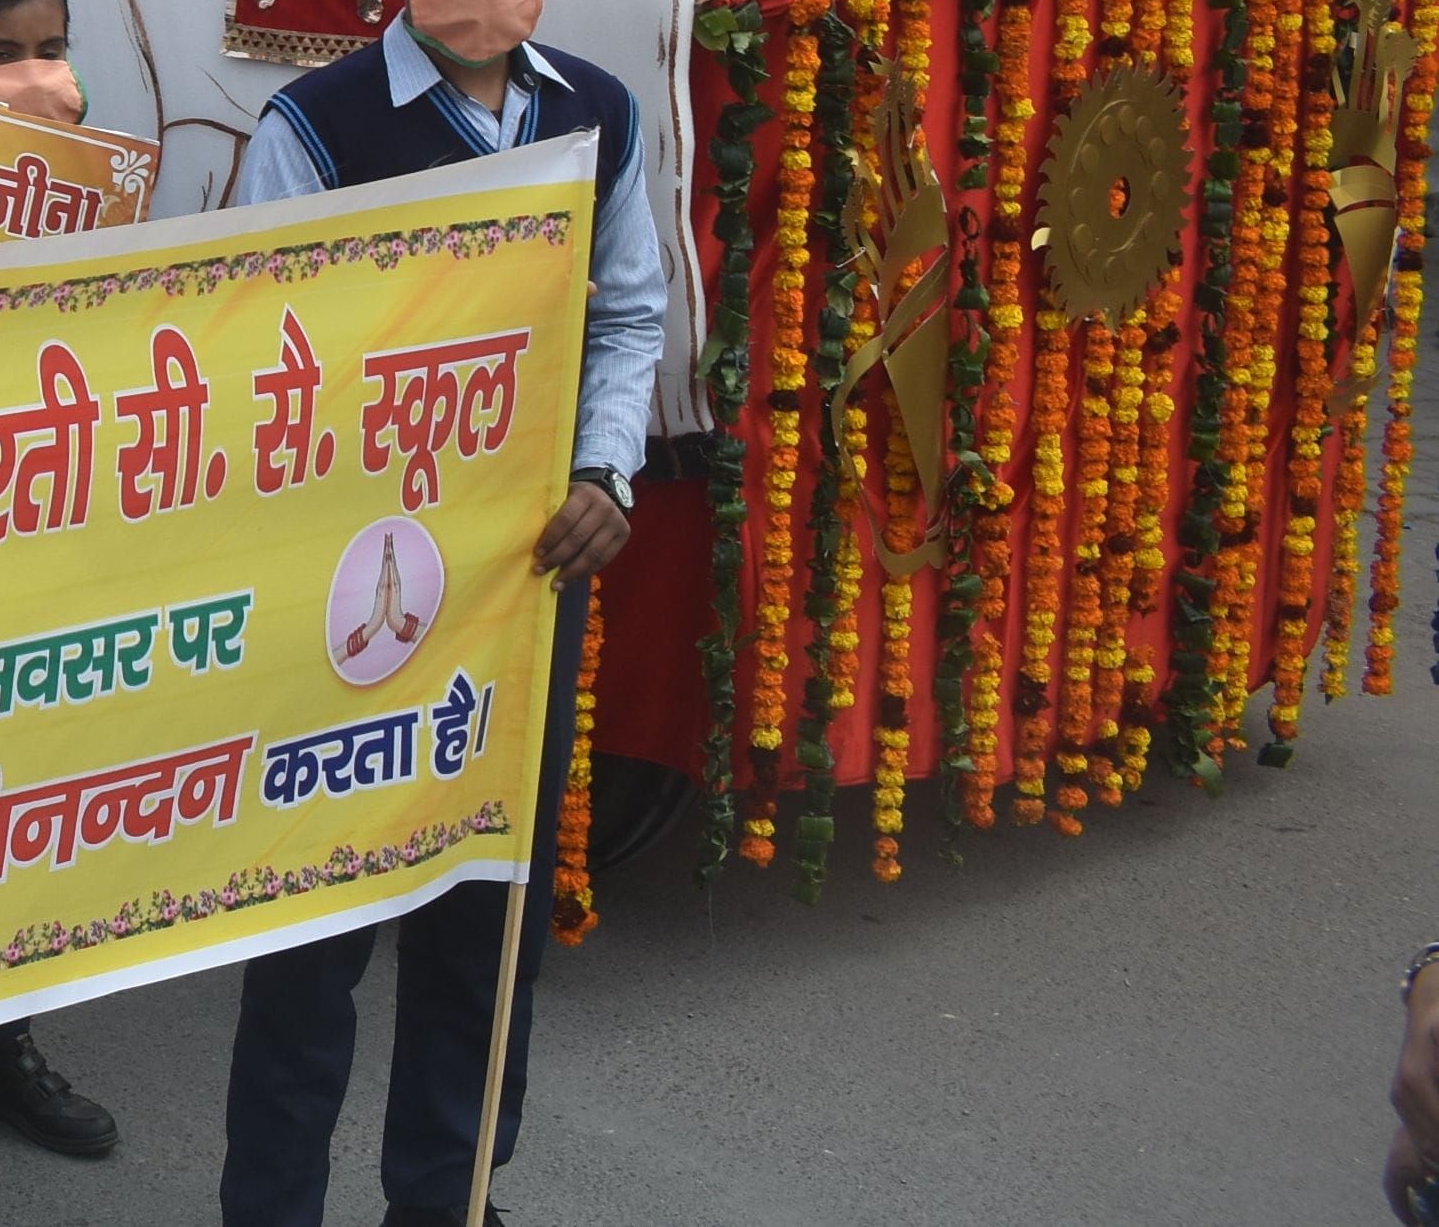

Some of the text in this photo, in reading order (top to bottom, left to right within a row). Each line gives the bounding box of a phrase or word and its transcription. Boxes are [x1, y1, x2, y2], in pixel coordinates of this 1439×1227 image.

[114, 323, 227, 523] सी.
[360, 326, 534, 514] स्कूल
[170, 589, 255, 676] पर
[260, 703, 421, 810] करता
[429, 668, 495, 781] है।
